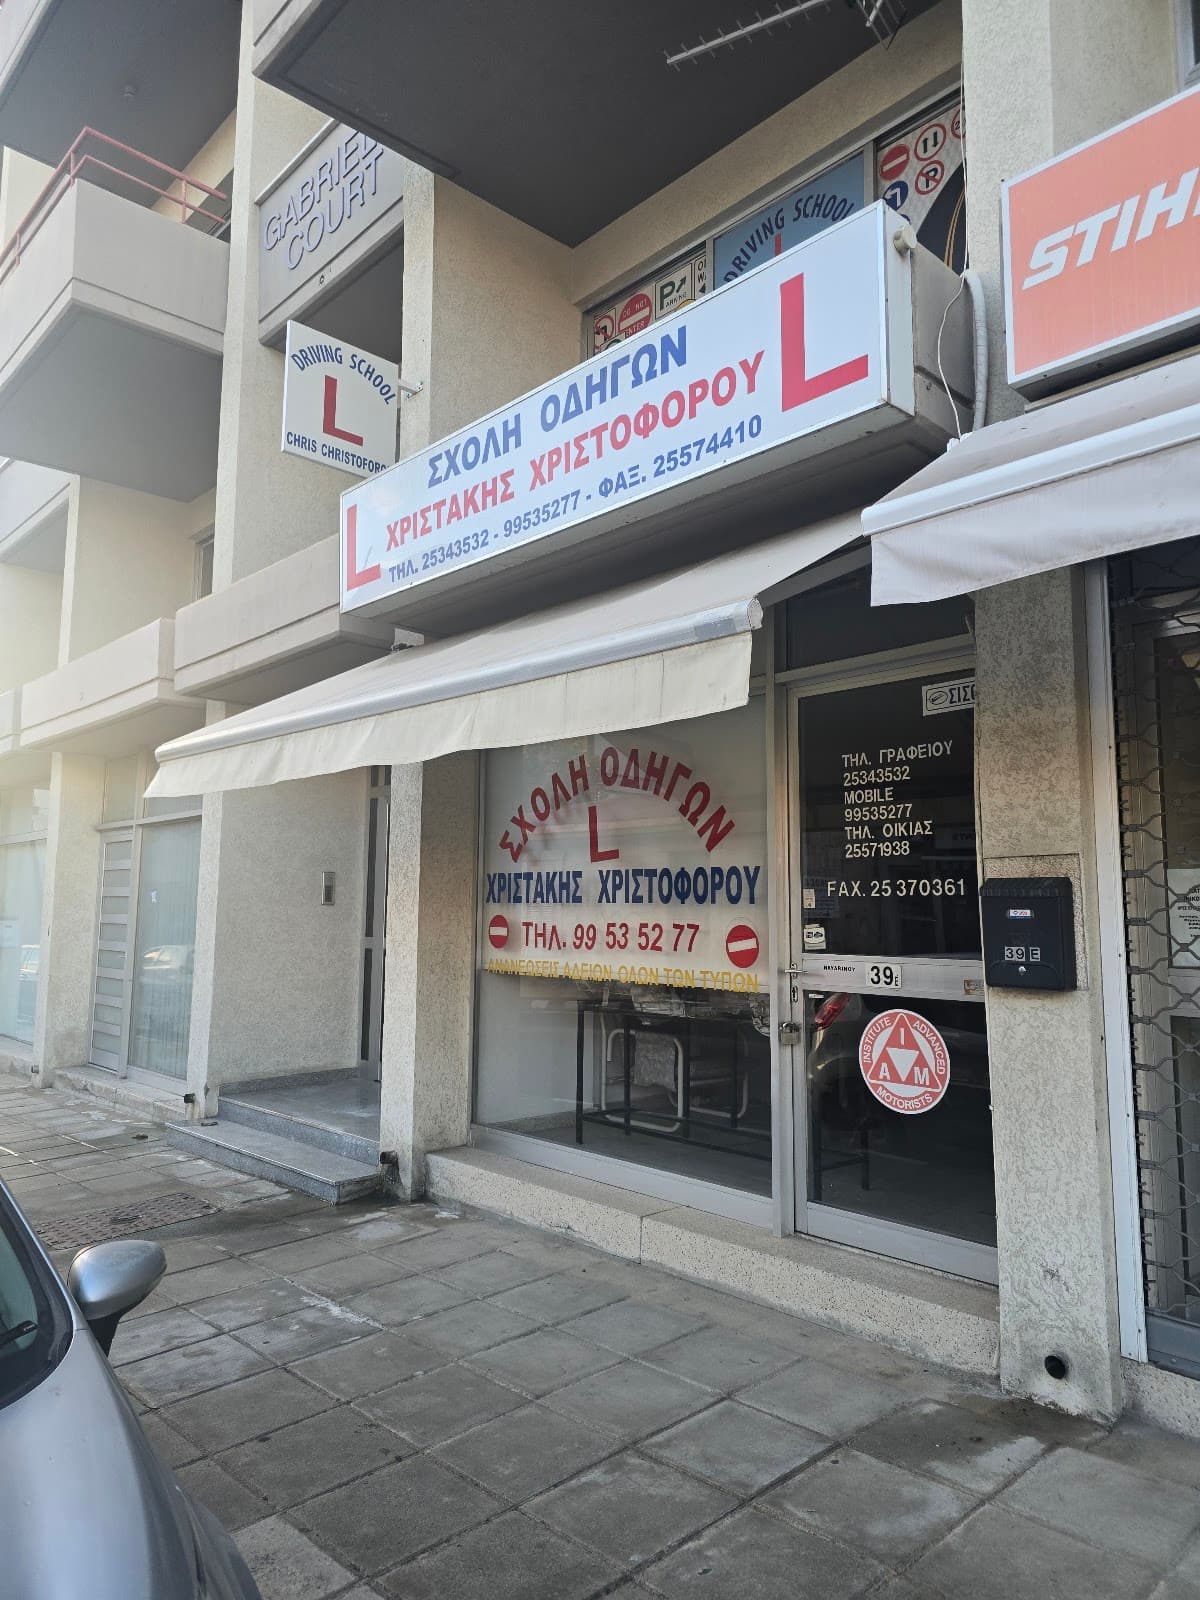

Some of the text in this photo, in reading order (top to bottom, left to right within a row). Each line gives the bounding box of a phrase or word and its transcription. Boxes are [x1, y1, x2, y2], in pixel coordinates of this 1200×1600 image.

[264, 130, 379, 251] GABRIEL
[287, 148, 384, 270] COURT
[723, 207, 785, 284] DRIVING
[1021, 167, 1200, 291] STIH
[779, 271, 869, 413] L
[291, 344, 396, 405] DRIVING SCHOOL
[322, 374, 364, 447] L
[427, 325, 687, 489] ΣΧΟΛΗ ΟΔΗΓΩΝ
[286, 431, 390, 474] CHRIS CHRISTOFOR
[386, 350, 765, 551] ΧΡΙΣΤΑΚΗΣ ΧΡΙΣΤΟΦΟΡΟΥ
[389, 559, 418, 583] ΤΗΛ.
[422, 528, 489, 570] 25343532
[503, 488, 581, 537] 99535277
[598, 464, 647, 498] ΦΑΞ.
[653, 414, 762, 478] 25574410
[346, 503, 382, 592] L
[842, 740, 953, 768] ΤΗΛ. ΓΡΑΦΕΙΟΥ
[843, 766, 911, 787] 25343532
[499, 747, 736, 863] ΣΧΟΛΗ ΟΔΗΓΩΝ
[844, 787, 894, 805] MOBILE
[844, 804, 913, 822] 99535277
[587, 805, 620, 863] L
[844, 825, 875, 840] ΤΗΛ.
[882, 820, 933, 838] ΟΙΚΙΑΣ
[845, 840, 910, 859] 25571938
[486, 870, 582, 904] ΧΡΙΣΤΑΚΗΣ
[597, 865, 761, 905] ΧΡΙΣΤΟΦΟΡΟΥ
[827, 881, 866, 897] FAX.
[521, 921, 700, 952] ΤΗΛ. 99 53 52 77
[1005, 947, 1025, 960] 39
[663, 967, 696, 990] ΤΩΝ
[700, 970, 760, 994] ΤΥΠΩΝ
[863, 1017, 892, 1063] INSTITUTE
[912, 1020, 946, 1075] ADVANCED
[878, 1062, 930, 1086] A M
[876, 1086, 933, 1110] MOTORISTS
